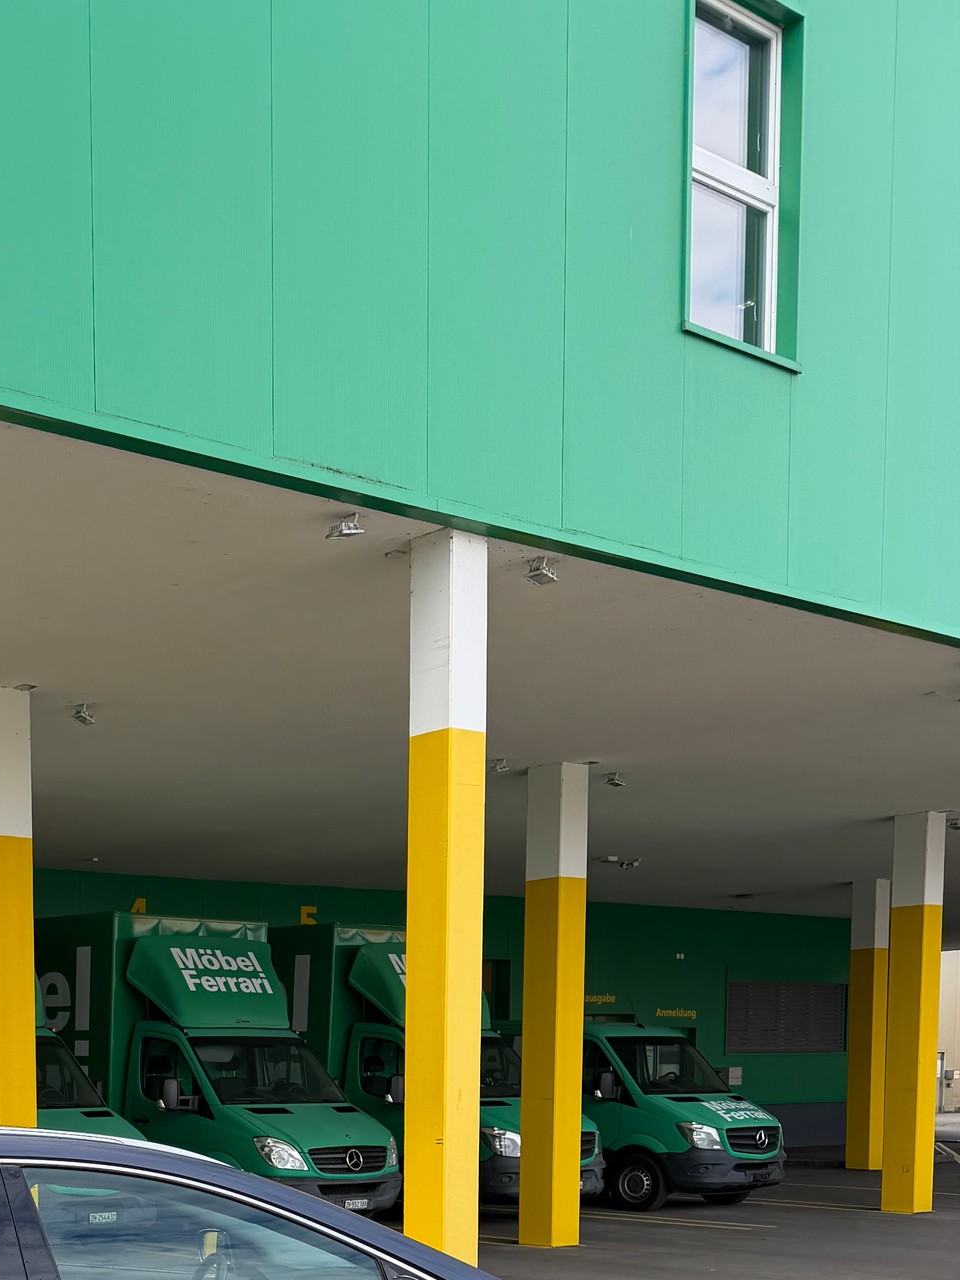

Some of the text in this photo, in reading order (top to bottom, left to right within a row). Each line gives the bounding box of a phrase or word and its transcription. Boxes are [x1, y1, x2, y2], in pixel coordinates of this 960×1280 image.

[169, 947, 263, 972] Möbel
[181, 969, 274, 994] Ferrari
[656, 1008, 697, 1019] Anmeldung
[716, 1109, 773, 1121] Ferrari
